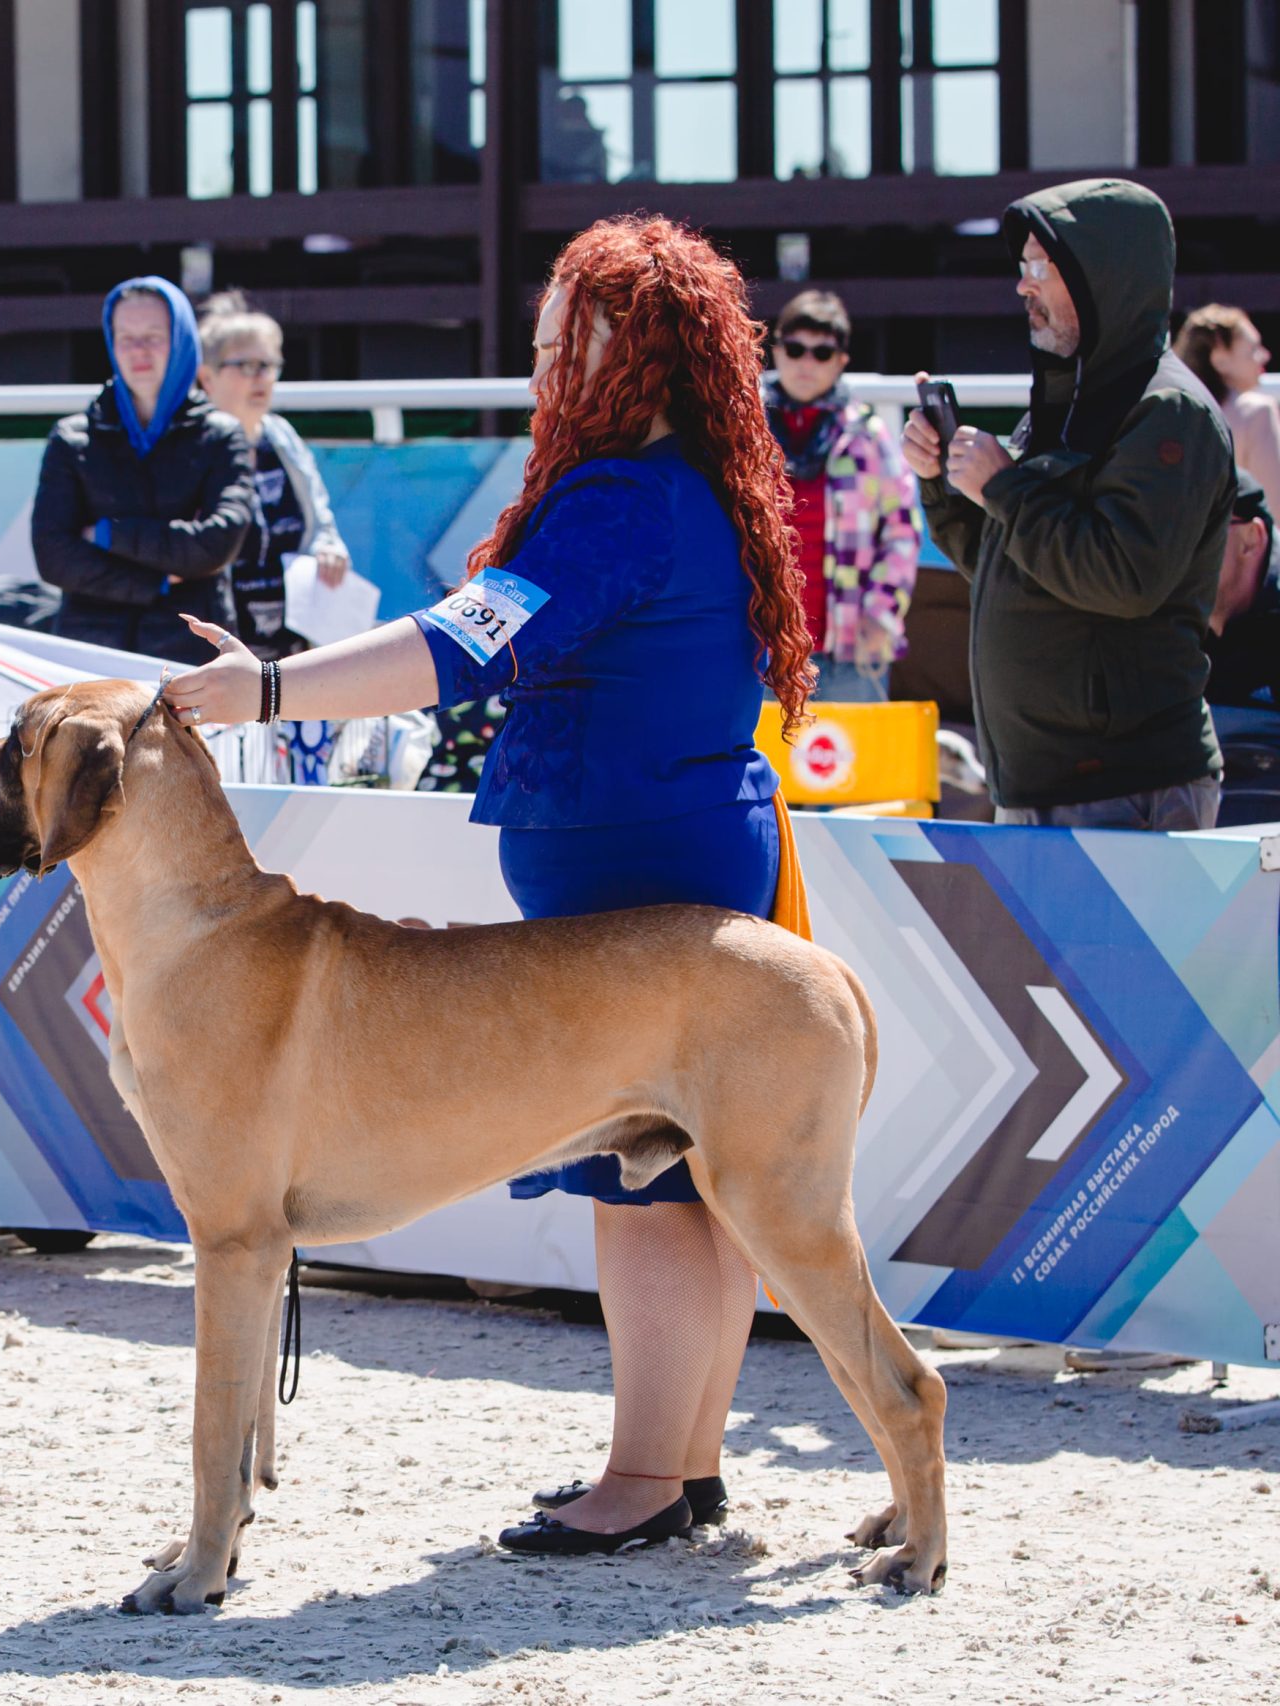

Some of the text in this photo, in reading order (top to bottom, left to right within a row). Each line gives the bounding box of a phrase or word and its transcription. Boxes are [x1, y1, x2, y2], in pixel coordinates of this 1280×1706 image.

[447, 595, 507, 642] 0691
[46, 893, 77, 937] КУБОК
[1011, 1123, 1144, 1285] II ВСЕМИРНАЯ ВЫСТАВКА
[1034, 1104, 1181, 1283] СОБАК РОССИЙСКИХ ПОРОД
